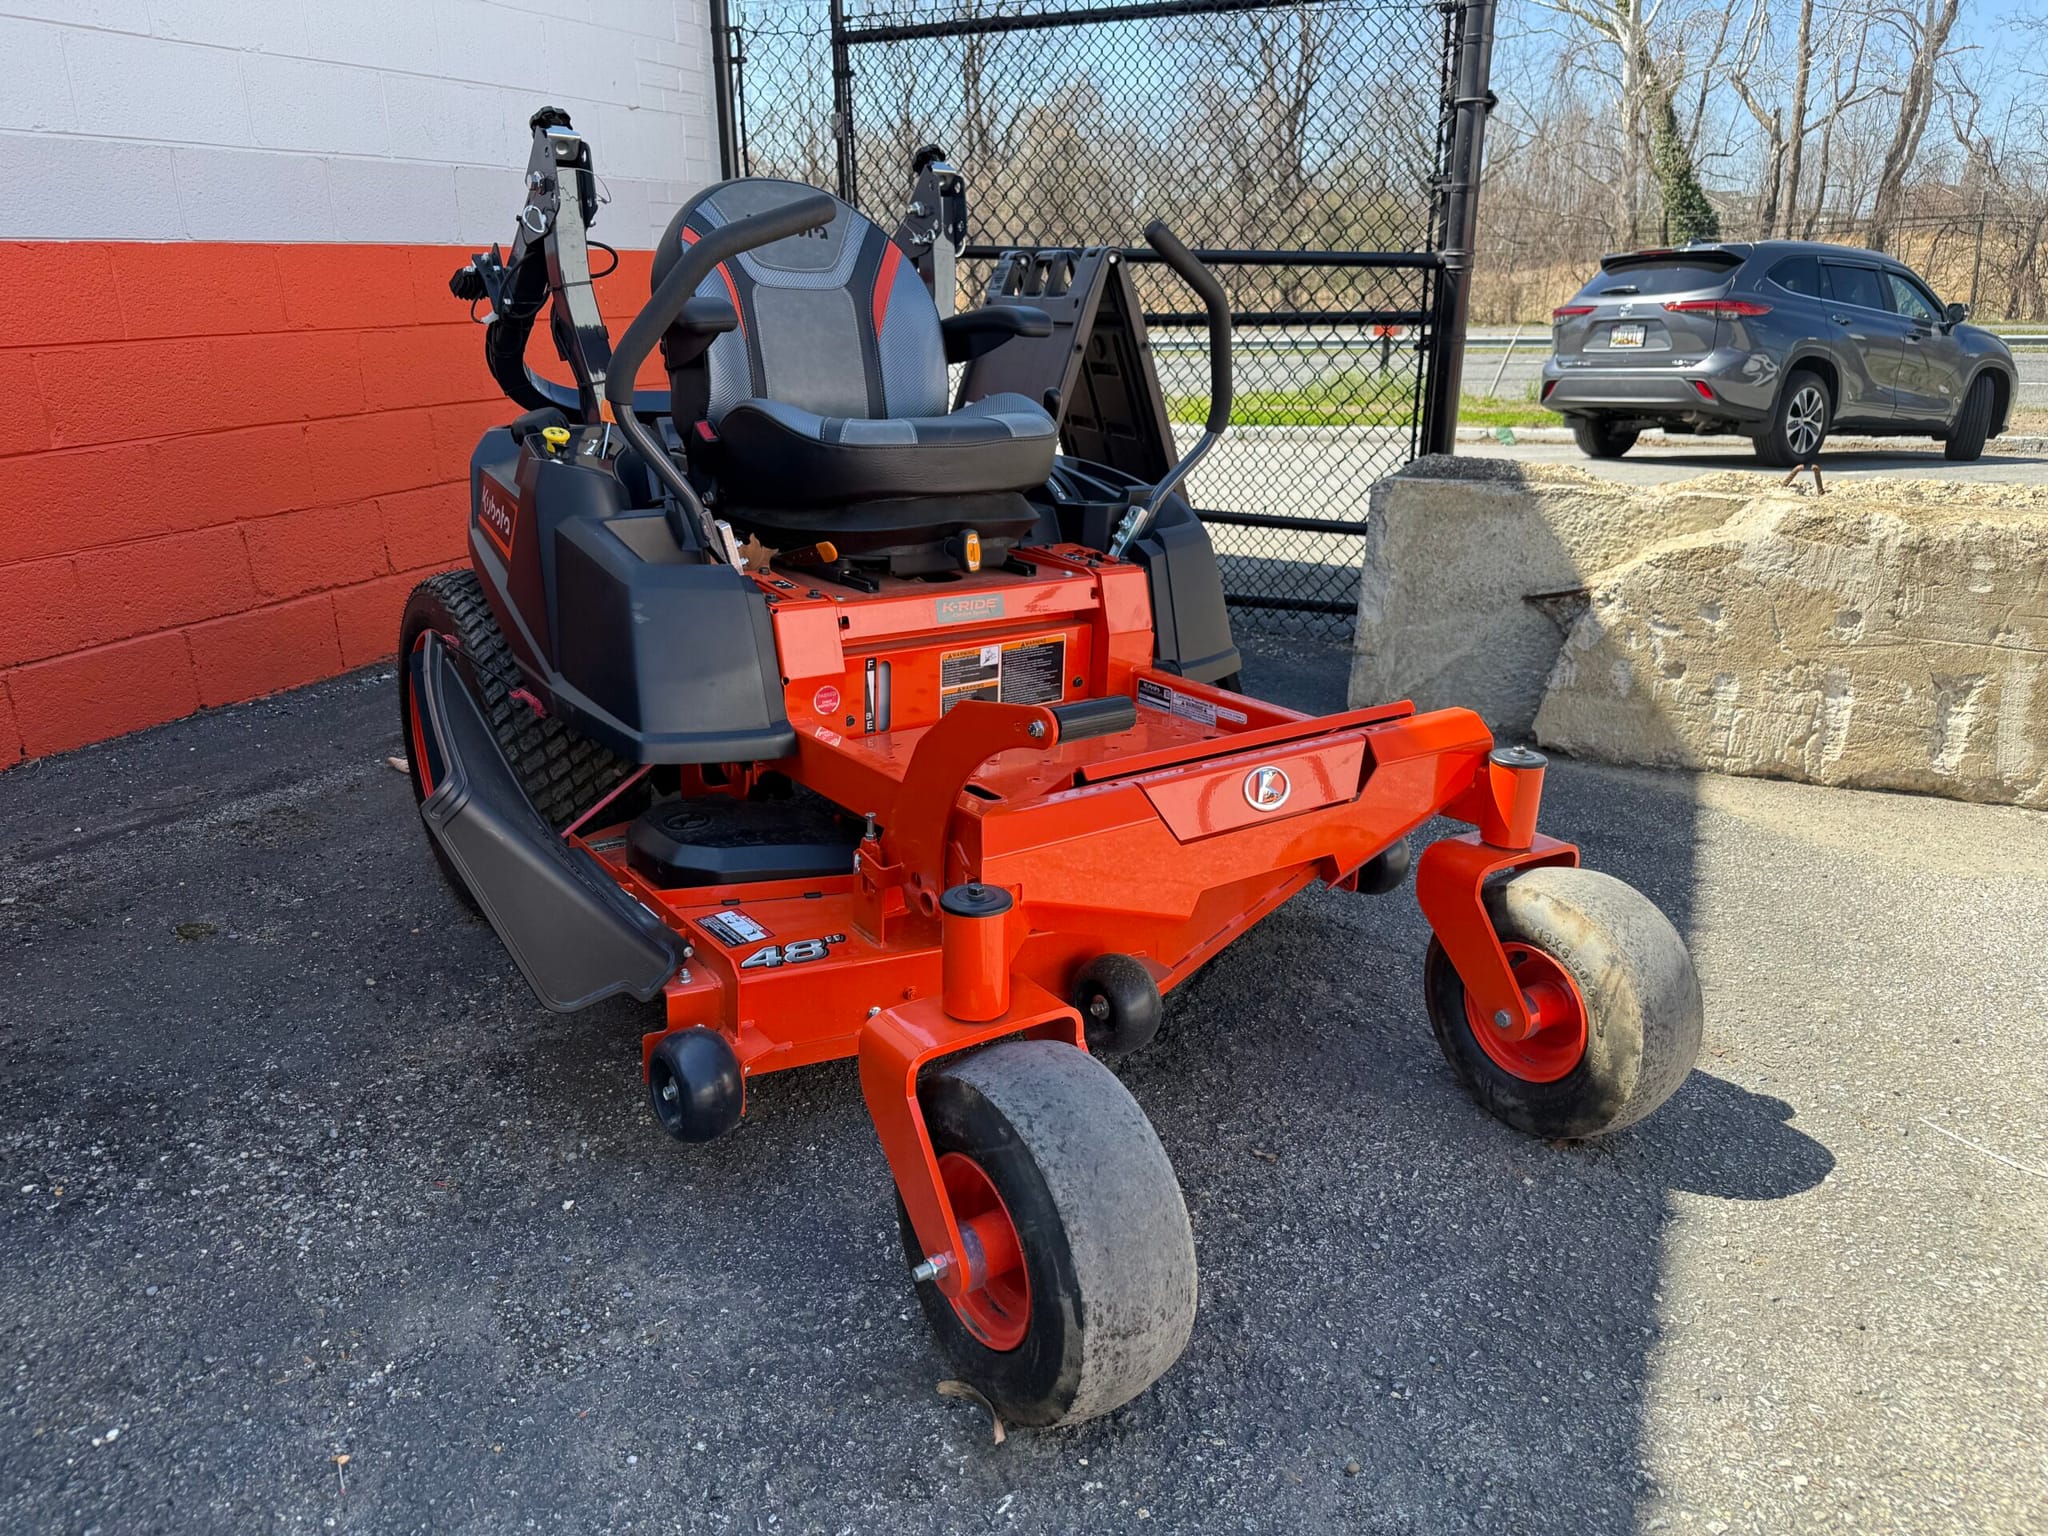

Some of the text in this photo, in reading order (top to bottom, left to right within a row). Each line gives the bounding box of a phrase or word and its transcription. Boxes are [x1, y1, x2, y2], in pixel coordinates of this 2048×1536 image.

[482, 486, 510, 536] Kubota
[943, 598, 998, 613] K-RIDE
[867, 660, 874, 669] F
[867, 721, 873, 729] E
